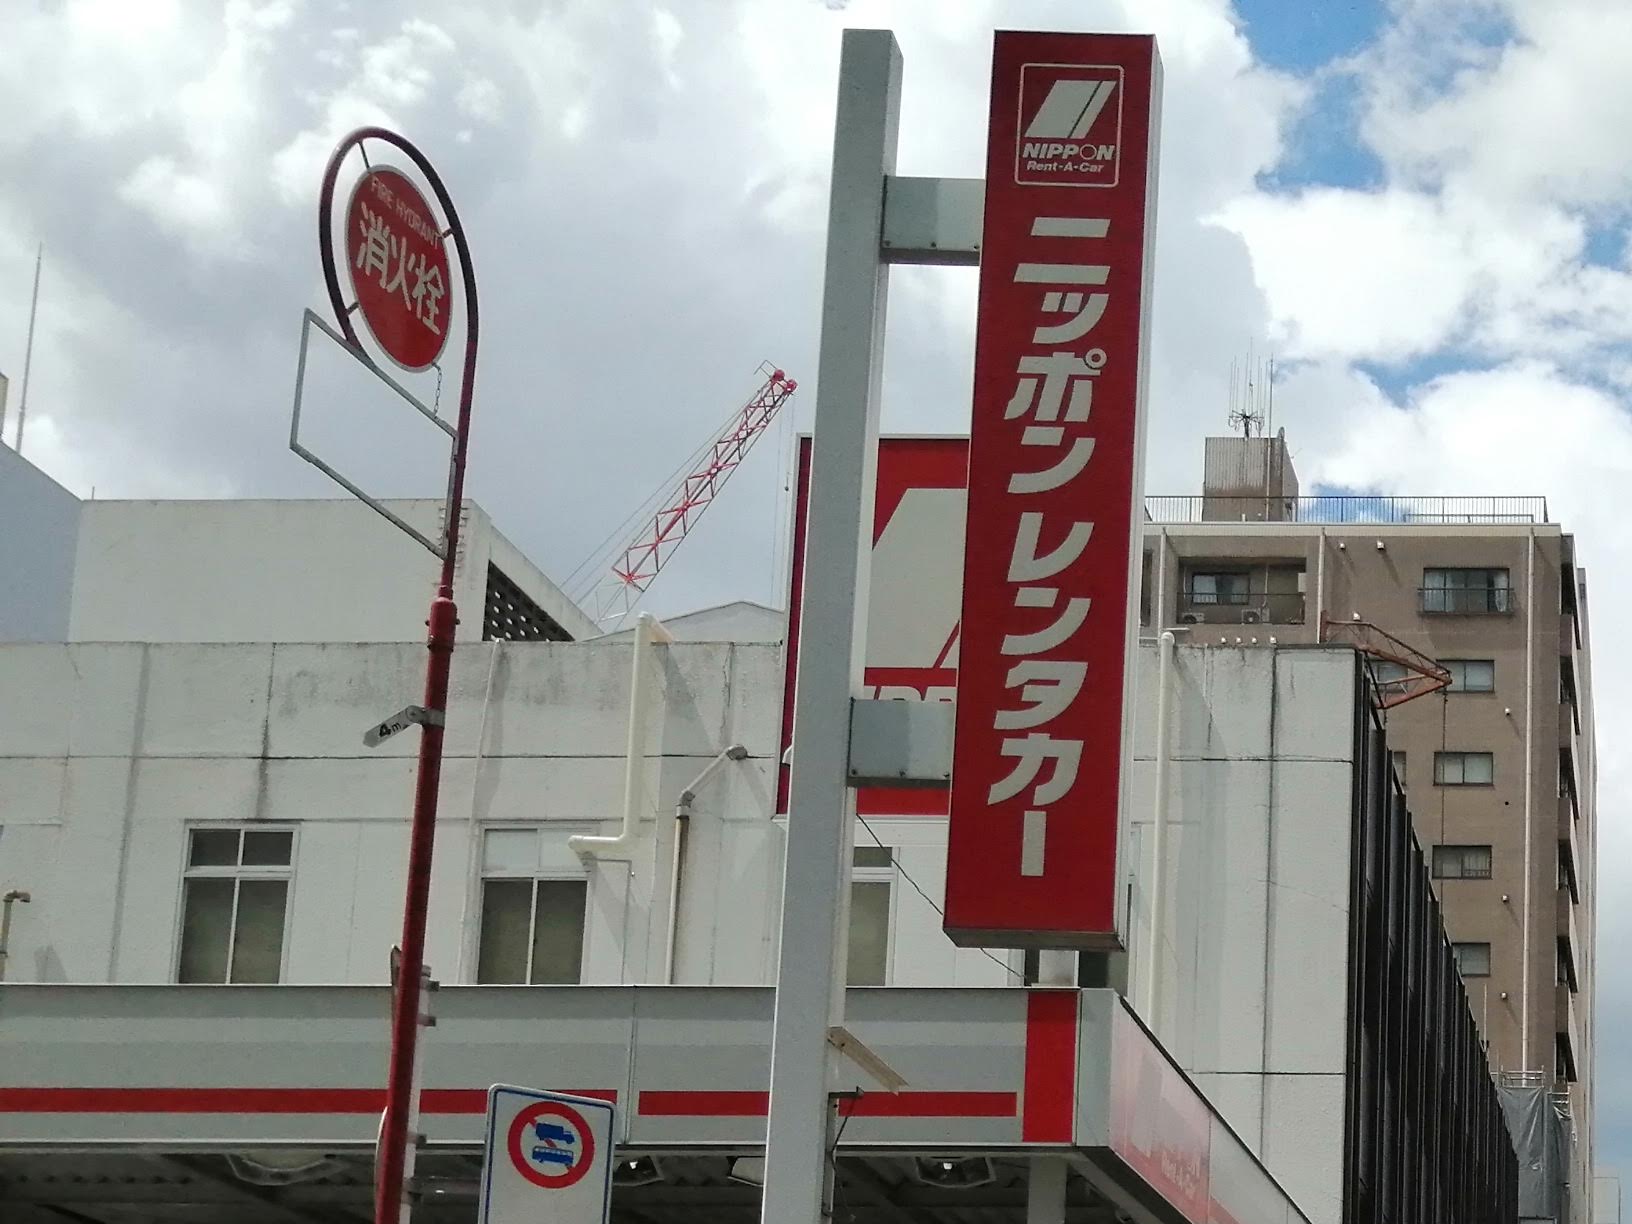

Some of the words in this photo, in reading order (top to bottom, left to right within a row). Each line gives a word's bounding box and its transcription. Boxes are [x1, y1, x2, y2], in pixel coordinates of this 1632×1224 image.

[1022, 143, 1116, 161] NIPPON
[1026, 160, 1105, 173] Rent-A-Car
[371, 175, 394, 209] FIRE
[395, 198, 441, 250] HYDRANT
[356, 201, 445, 336] 消火栓
[986, 217, 1111, 877] ニッポンレンタカー
